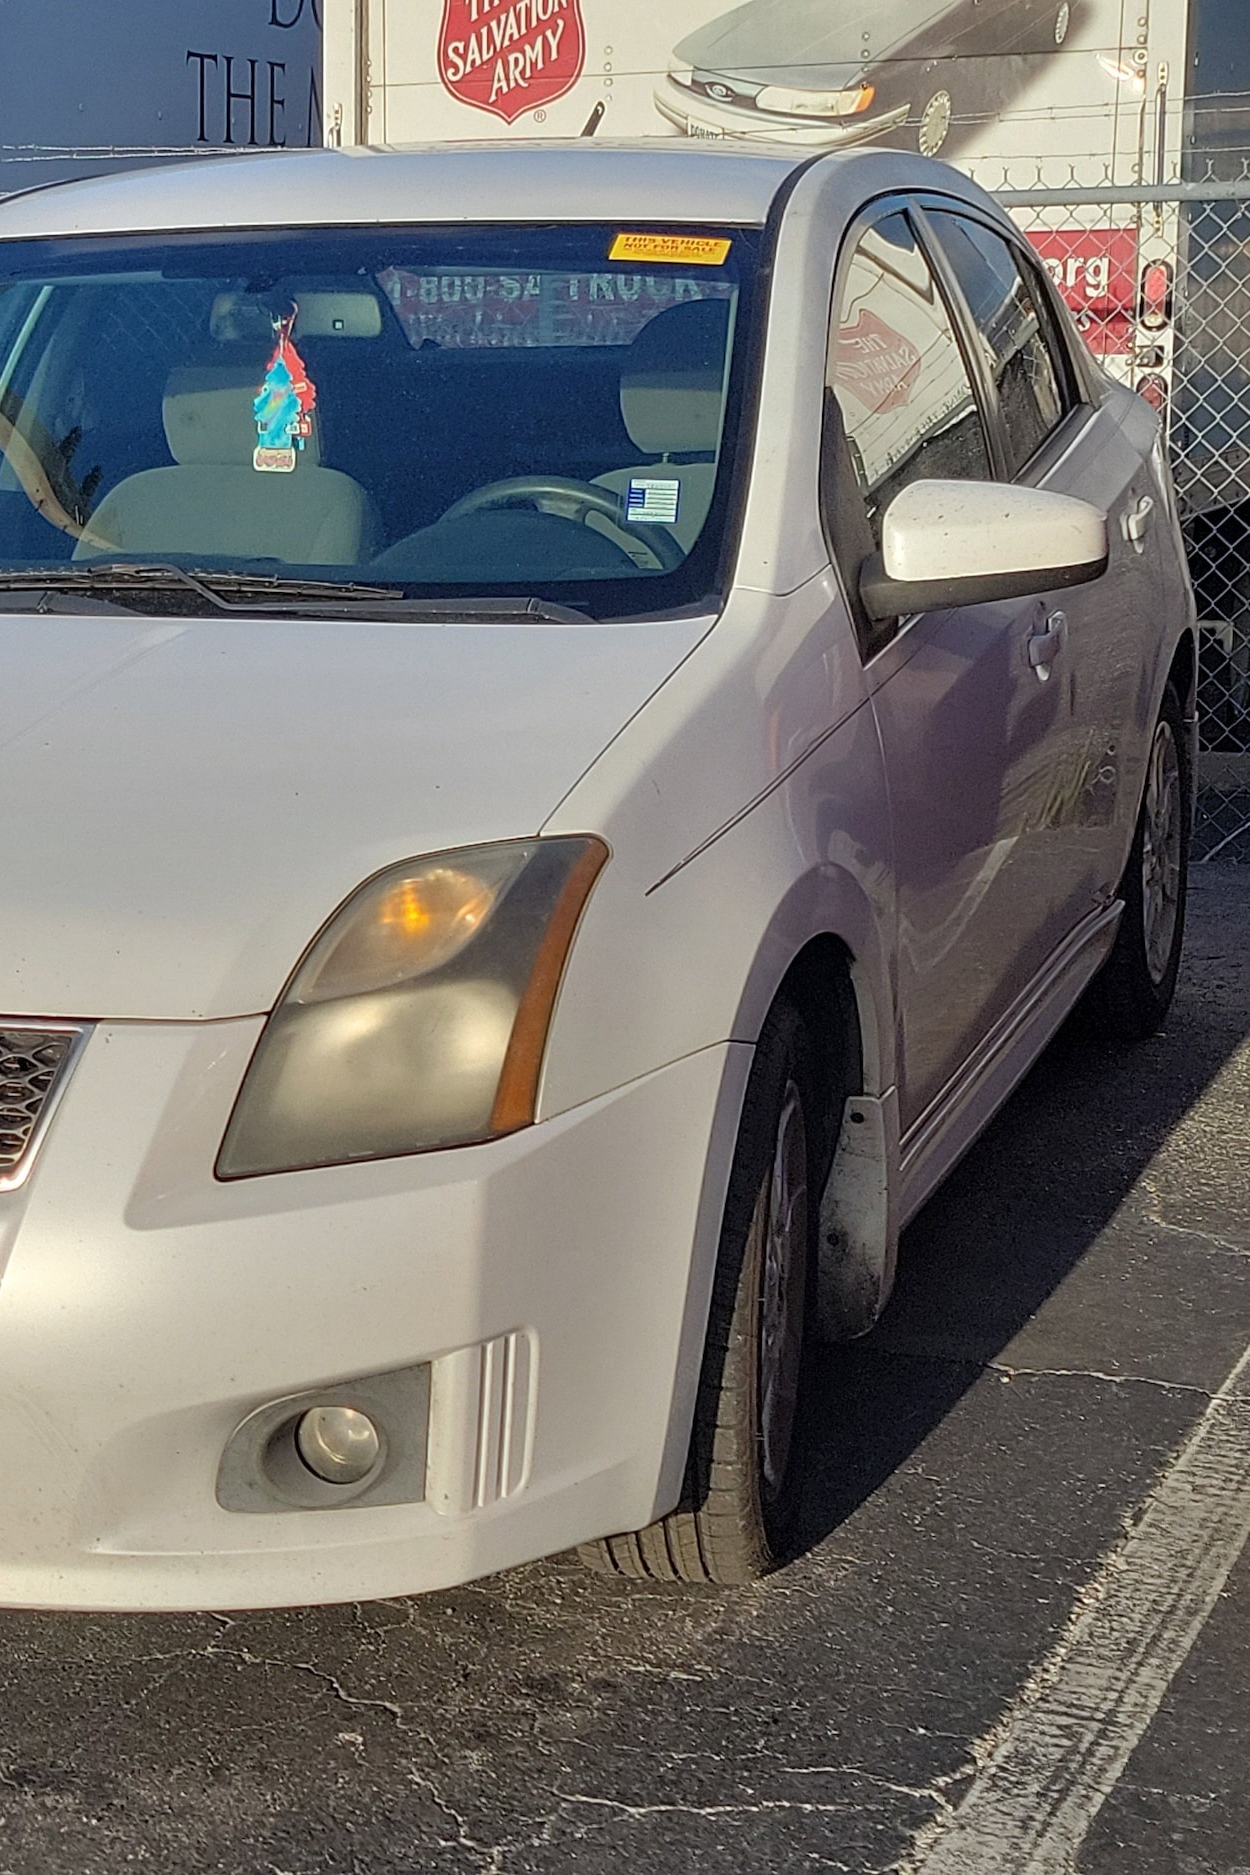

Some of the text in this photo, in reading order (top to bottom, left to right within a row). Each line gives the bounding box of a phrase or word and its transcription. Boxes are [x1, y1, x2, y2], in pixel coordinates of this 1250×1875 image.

[185, 50, 286, 147] THE
[489, 18, 564, 103] ARMY
[624, 236, 723, 248] THIS VEHICLE
